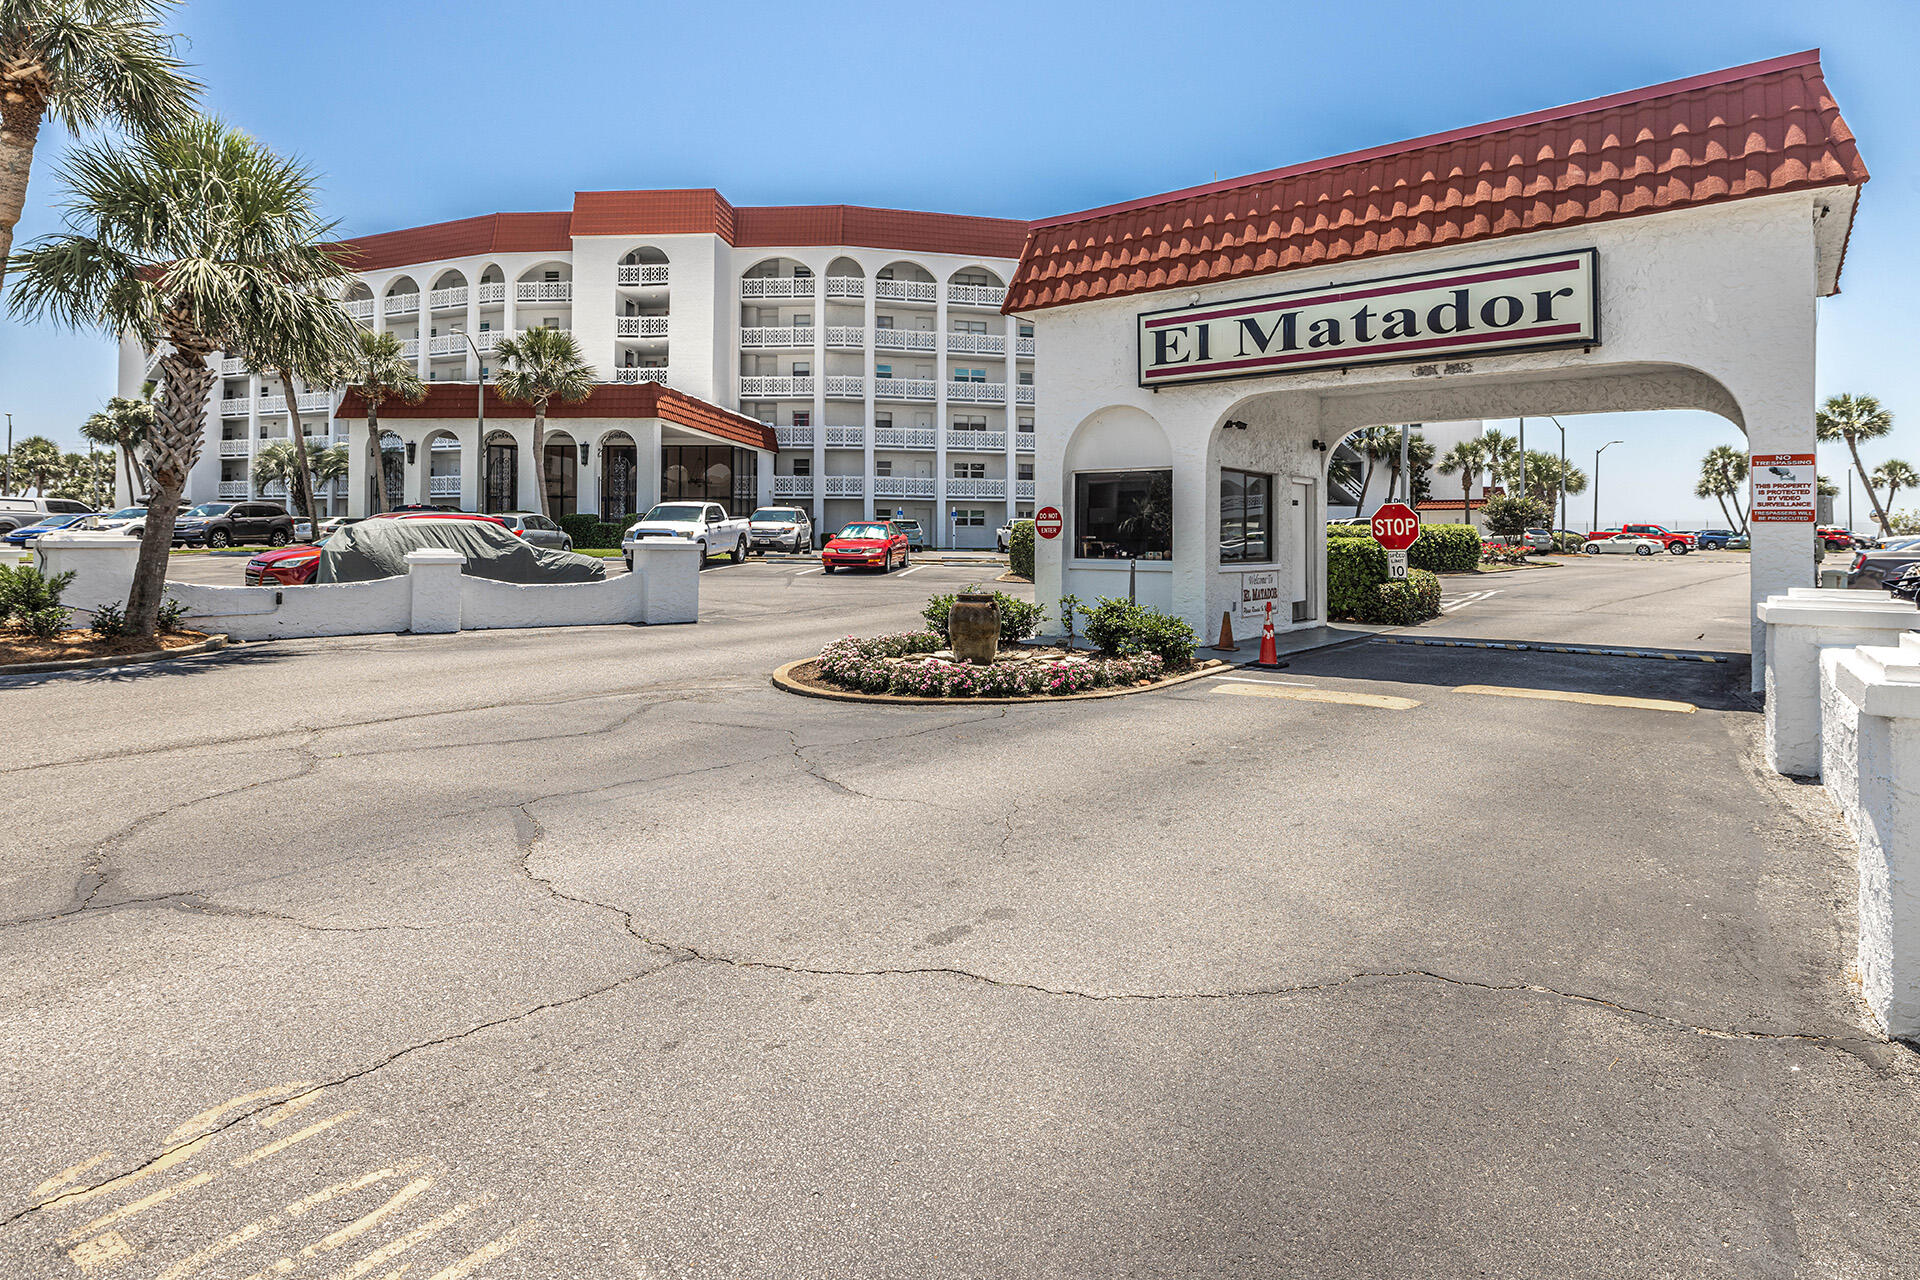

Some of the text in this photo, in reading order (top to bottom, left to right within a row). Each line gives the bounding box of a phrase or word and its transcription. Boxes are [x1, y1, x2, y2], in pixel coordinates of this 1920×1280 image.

[1149, 287, 1574, 366] El Matador
[1375, 518, 1416, 536] STOP
[1392, 566, 1405, 576] 10
[1243, 587, 1278, 602] EL MATADOR
